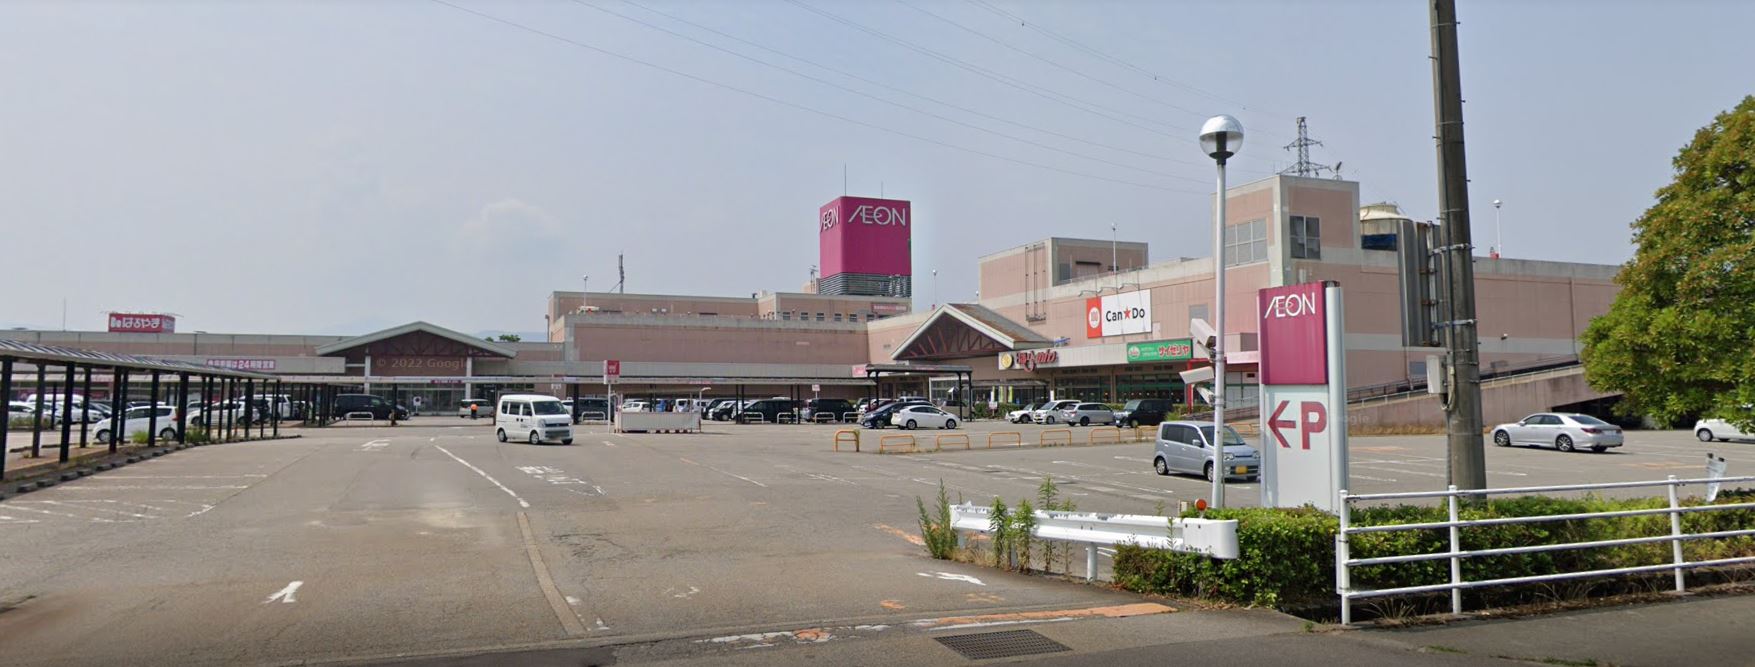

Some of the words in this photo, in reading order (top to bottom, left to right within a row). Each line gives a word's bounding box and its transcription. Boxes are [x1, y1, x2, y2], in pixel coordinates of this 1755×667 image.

[122, 317, 160, 328] はるやま
[1158, 344, 1190, 357] サイゼリヤ
[1301, 401, 1327, 450] P
